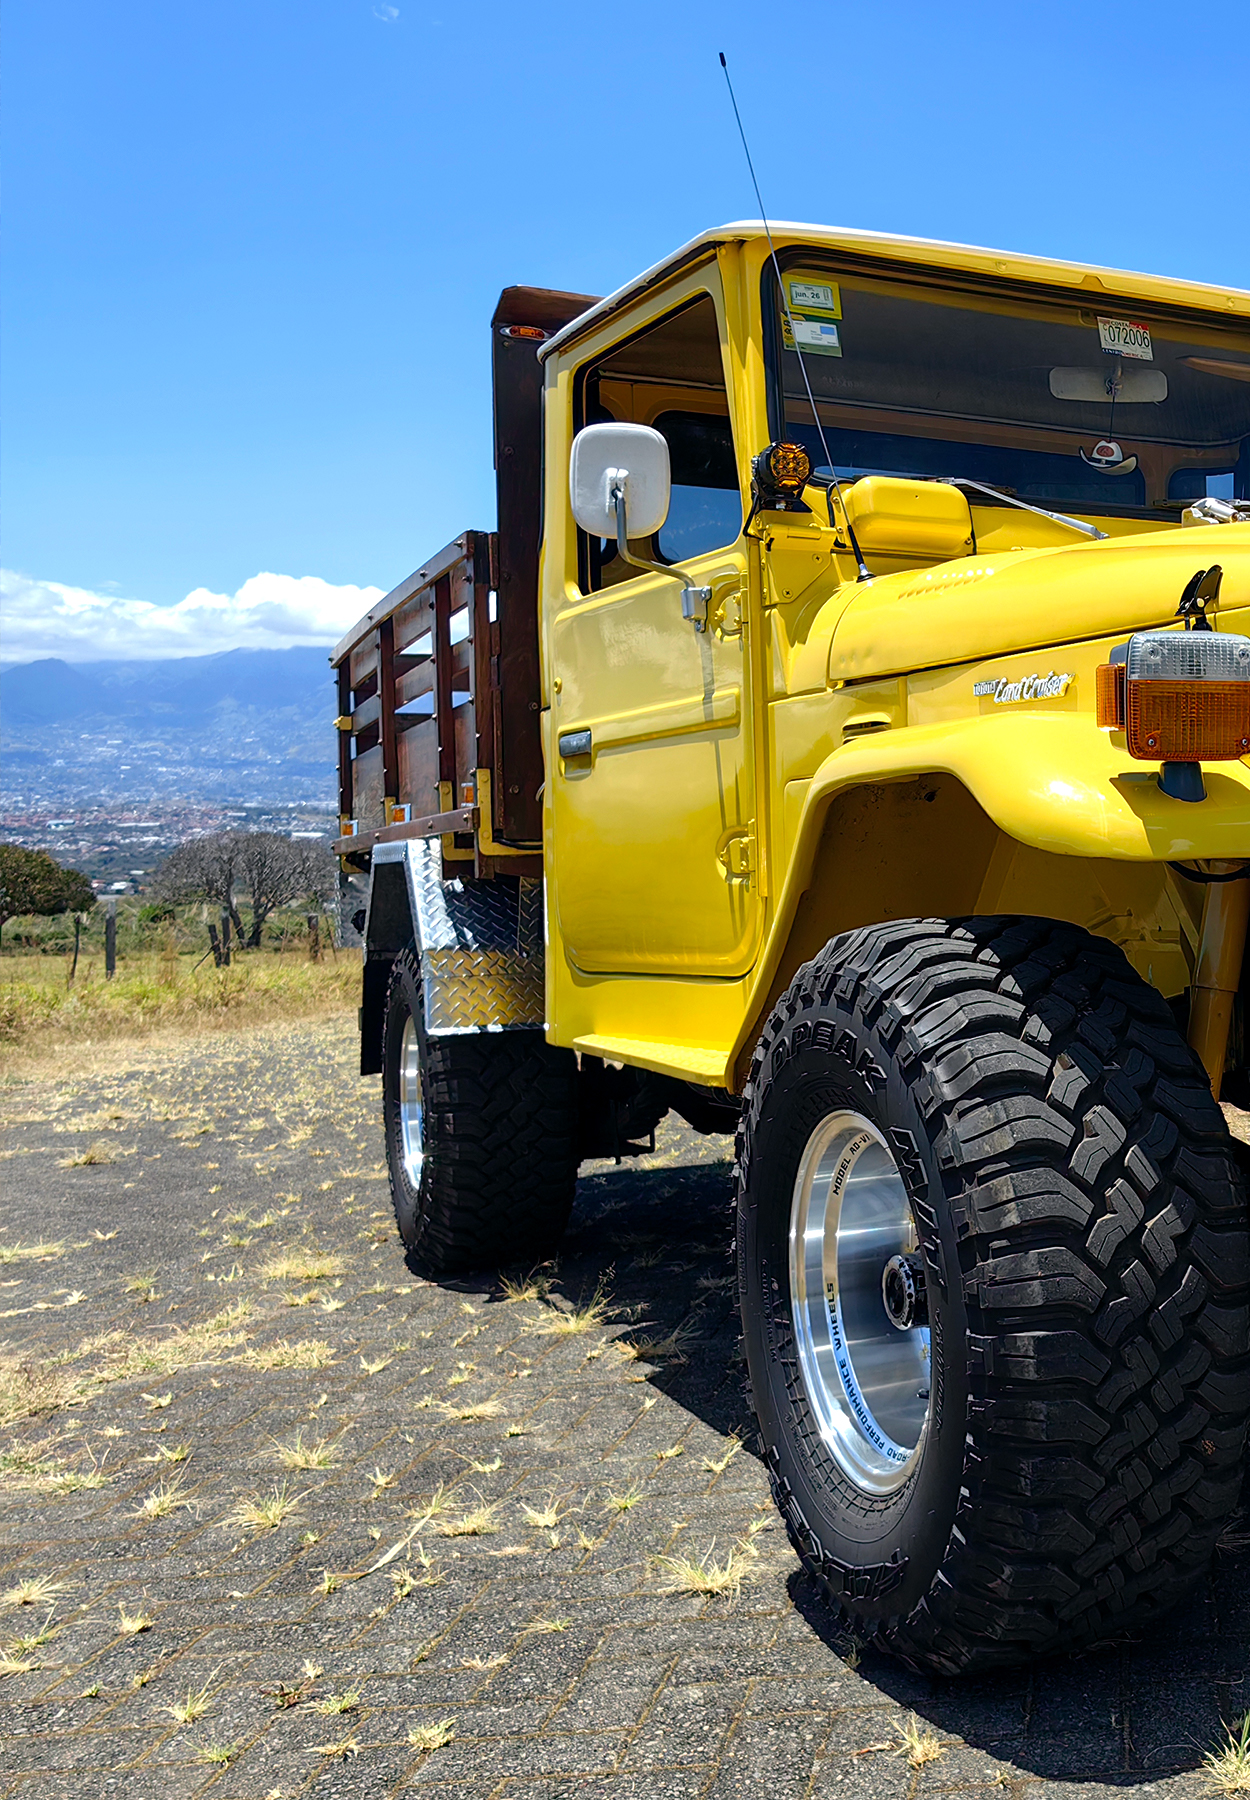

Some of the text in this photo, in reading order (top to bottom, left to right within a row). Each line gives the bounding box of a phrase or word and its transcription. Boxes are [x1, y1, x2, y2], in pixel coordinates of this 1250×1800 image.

[810, 291, 821, 299] 26
[1108, 325, 1150, 348] 072006
[1022, 670, 1075, 700] Cruiser
[833, 1158, 851, 1196] MODEL
[826, 1282, 842, 1351] WHEELS
[839, 1358, 886, 1450] PERFORMANCE
